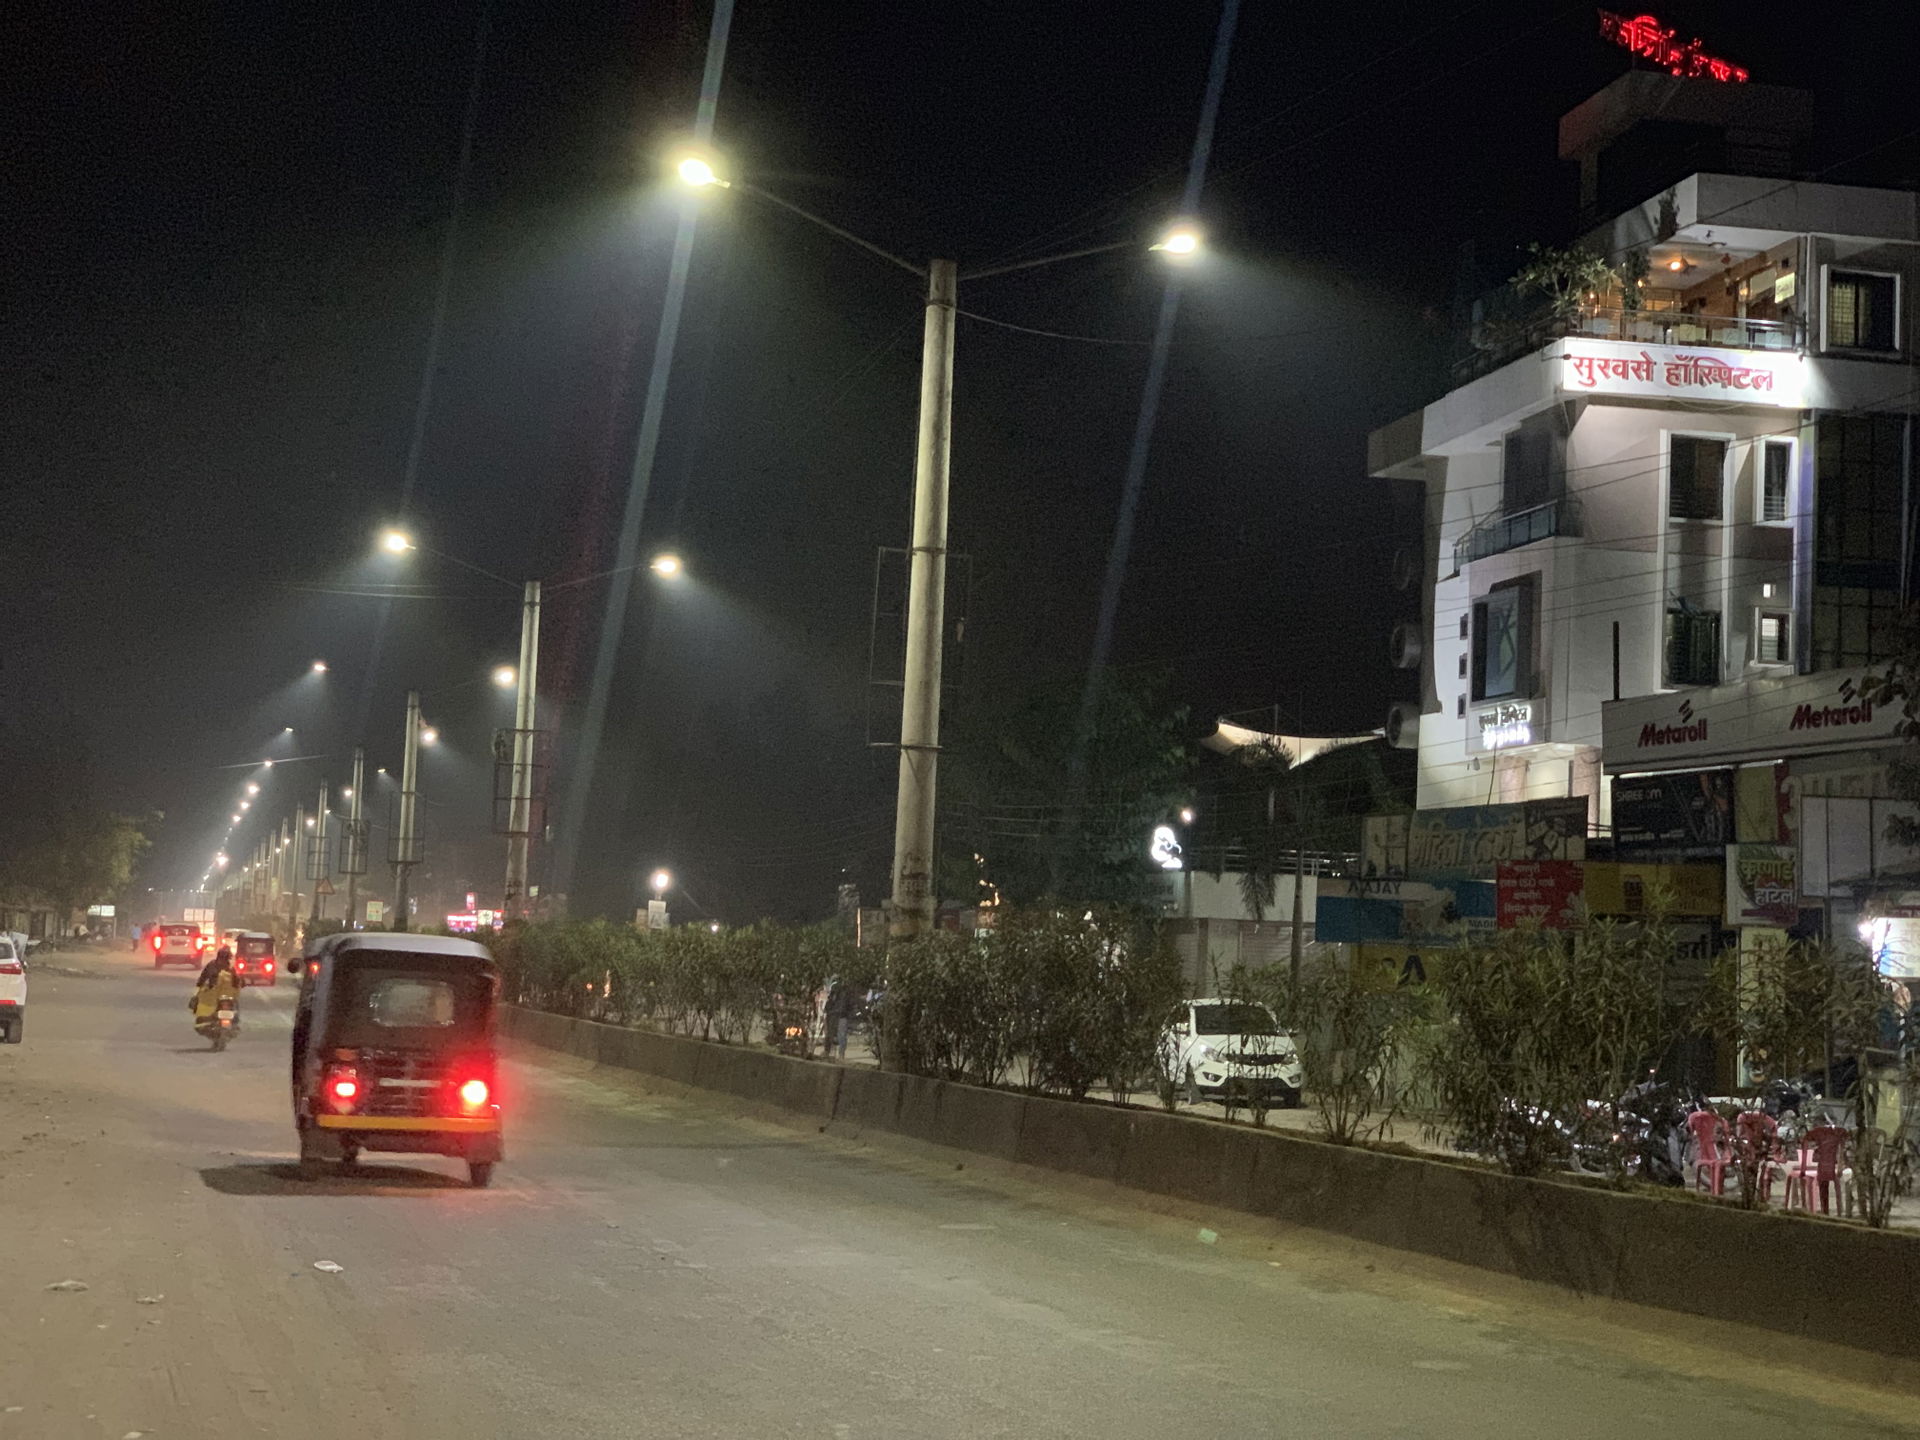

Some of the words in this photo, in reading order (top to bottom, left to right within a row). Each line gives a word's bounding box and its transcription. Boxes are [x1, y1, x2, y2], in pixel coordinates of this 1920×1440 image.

[1571, 351, 1657, 388] सुरवसे
[1664, 354, 1773, 391] हॉस्पिटल
[1789, 698, 1873, 730] Metaroll
[1638, 718, 1708, 748] Metaroll
